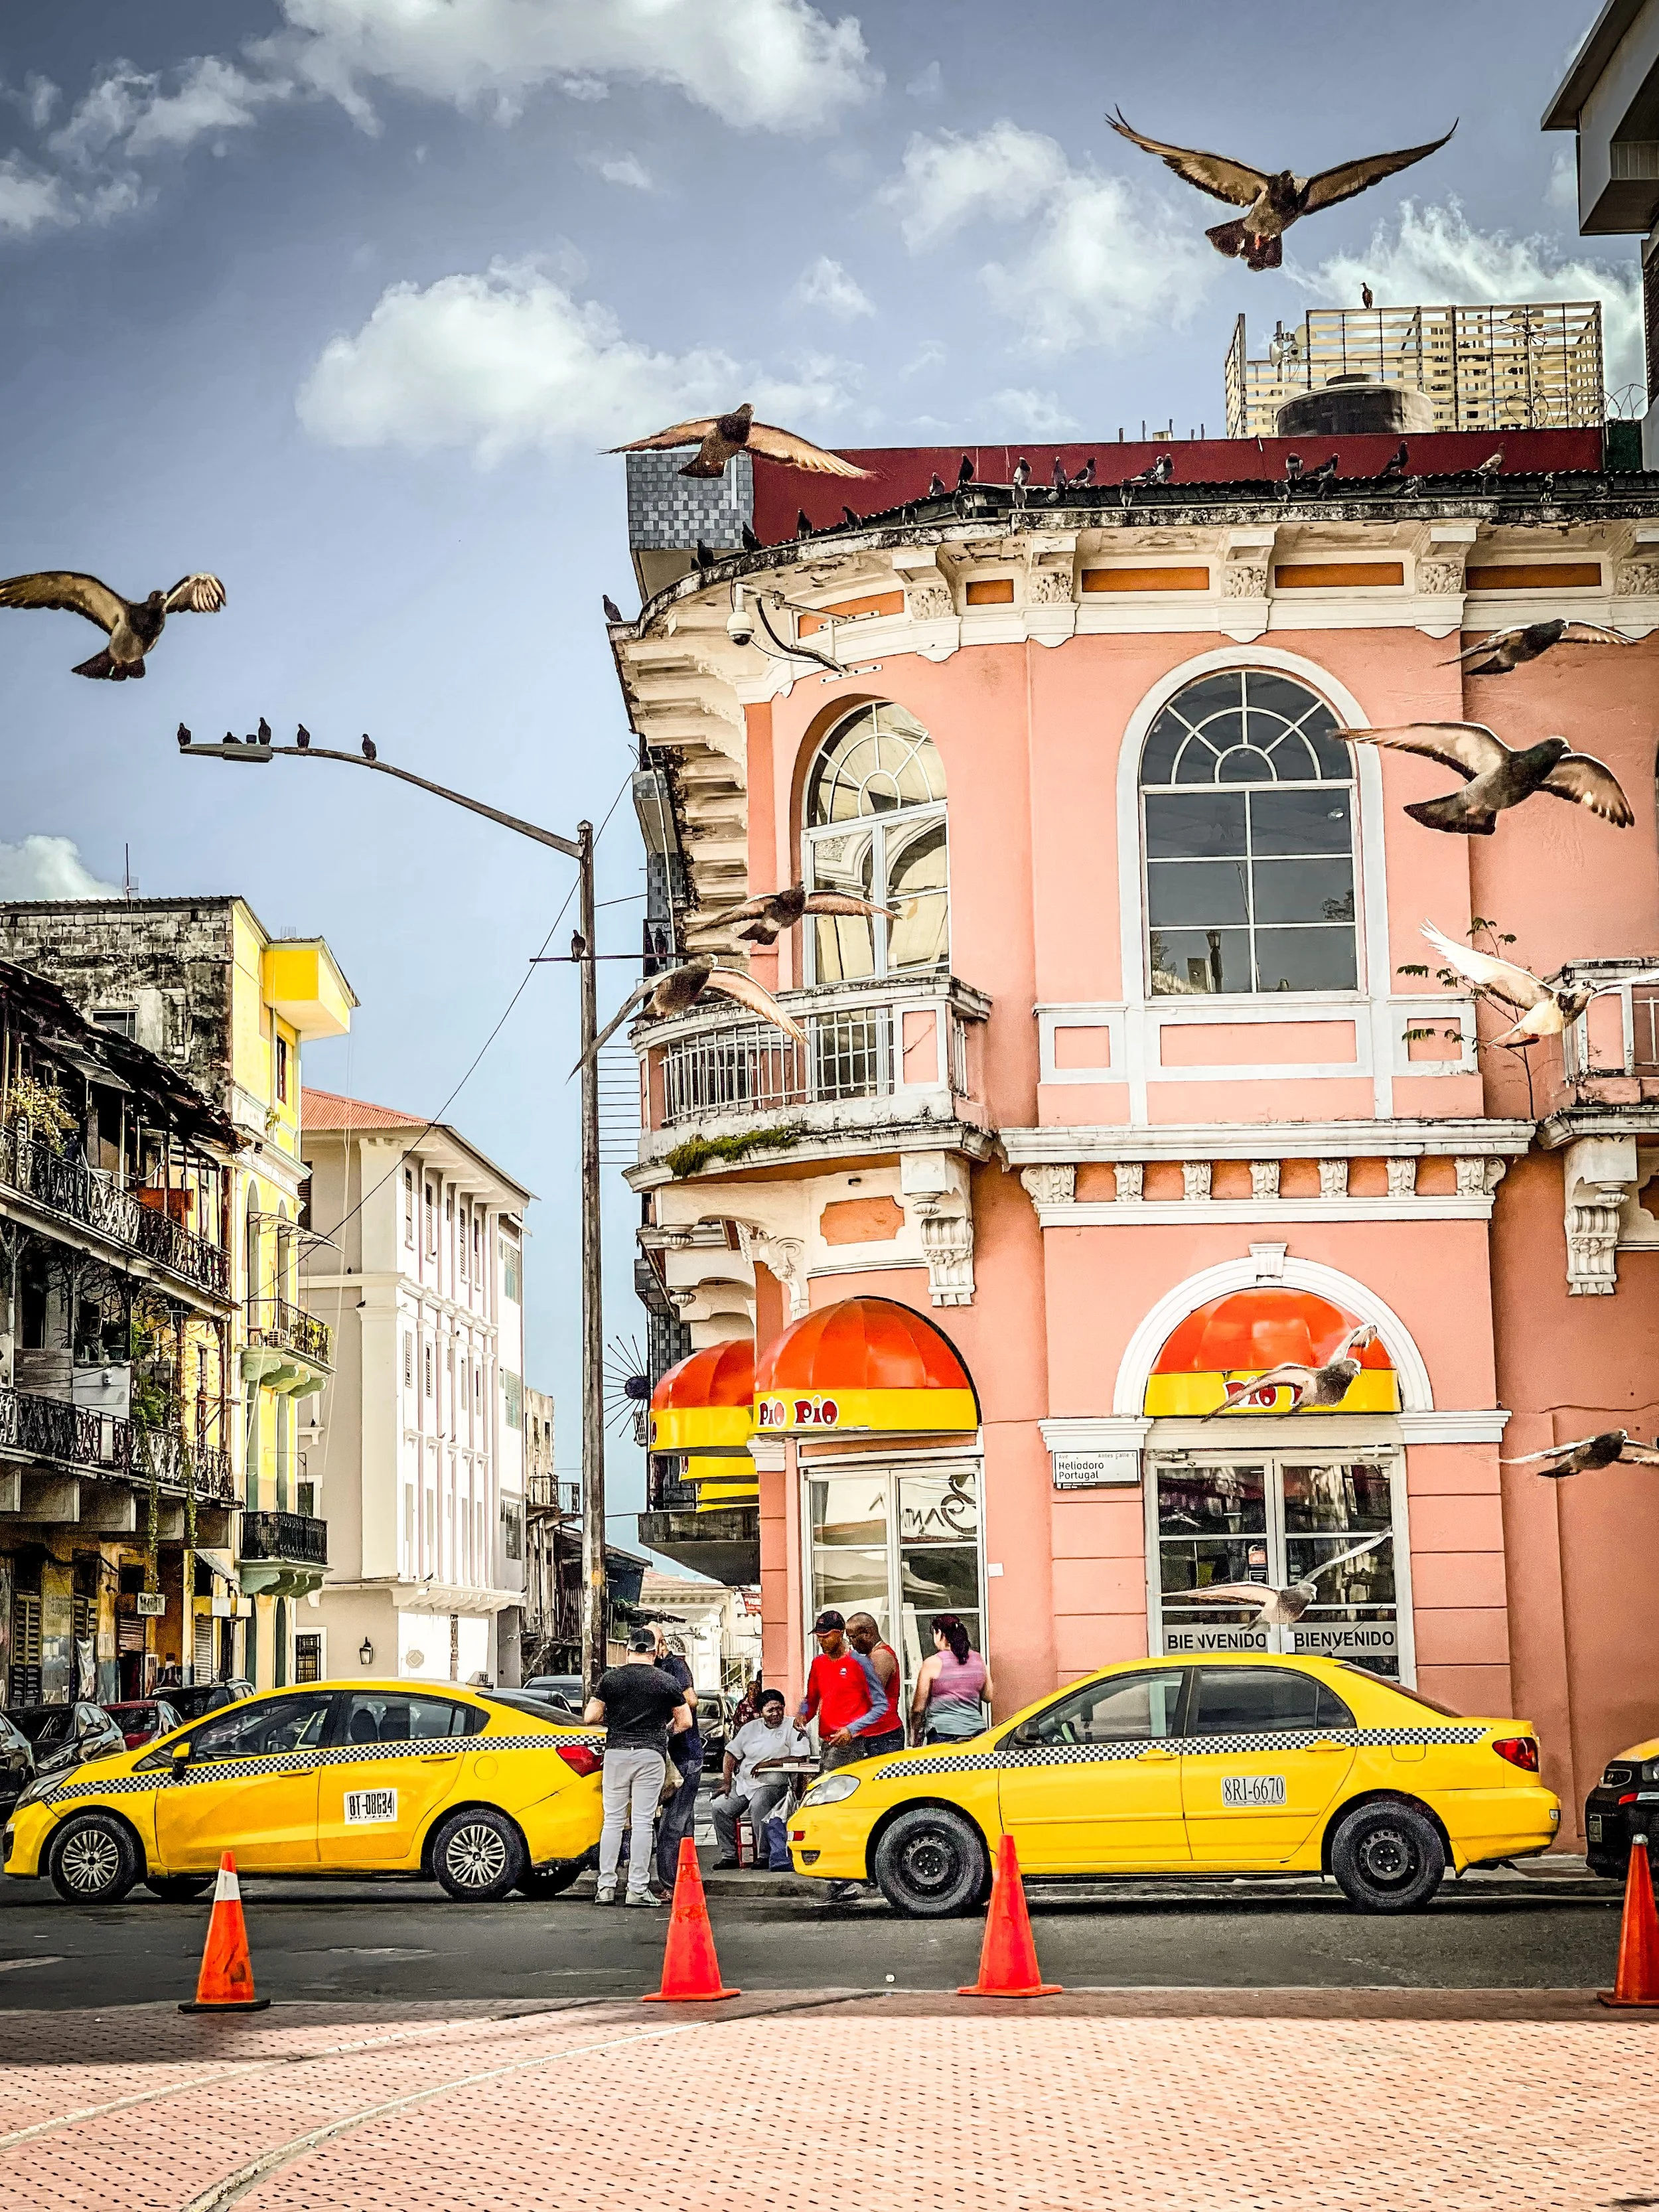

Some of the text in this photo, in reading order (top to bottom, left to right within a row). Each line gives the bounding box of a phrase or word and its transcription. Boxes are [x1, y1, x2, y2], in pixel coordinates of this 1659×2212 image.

[1058, 1461, 1104, 1470] Heliodoro
[1059, 1470, 1099, 1481] Portugal
[1167, 1633, 1267, 1649] BIENVENIDO
[1295, 1631, 1394, 1647] BIENVENIDO
